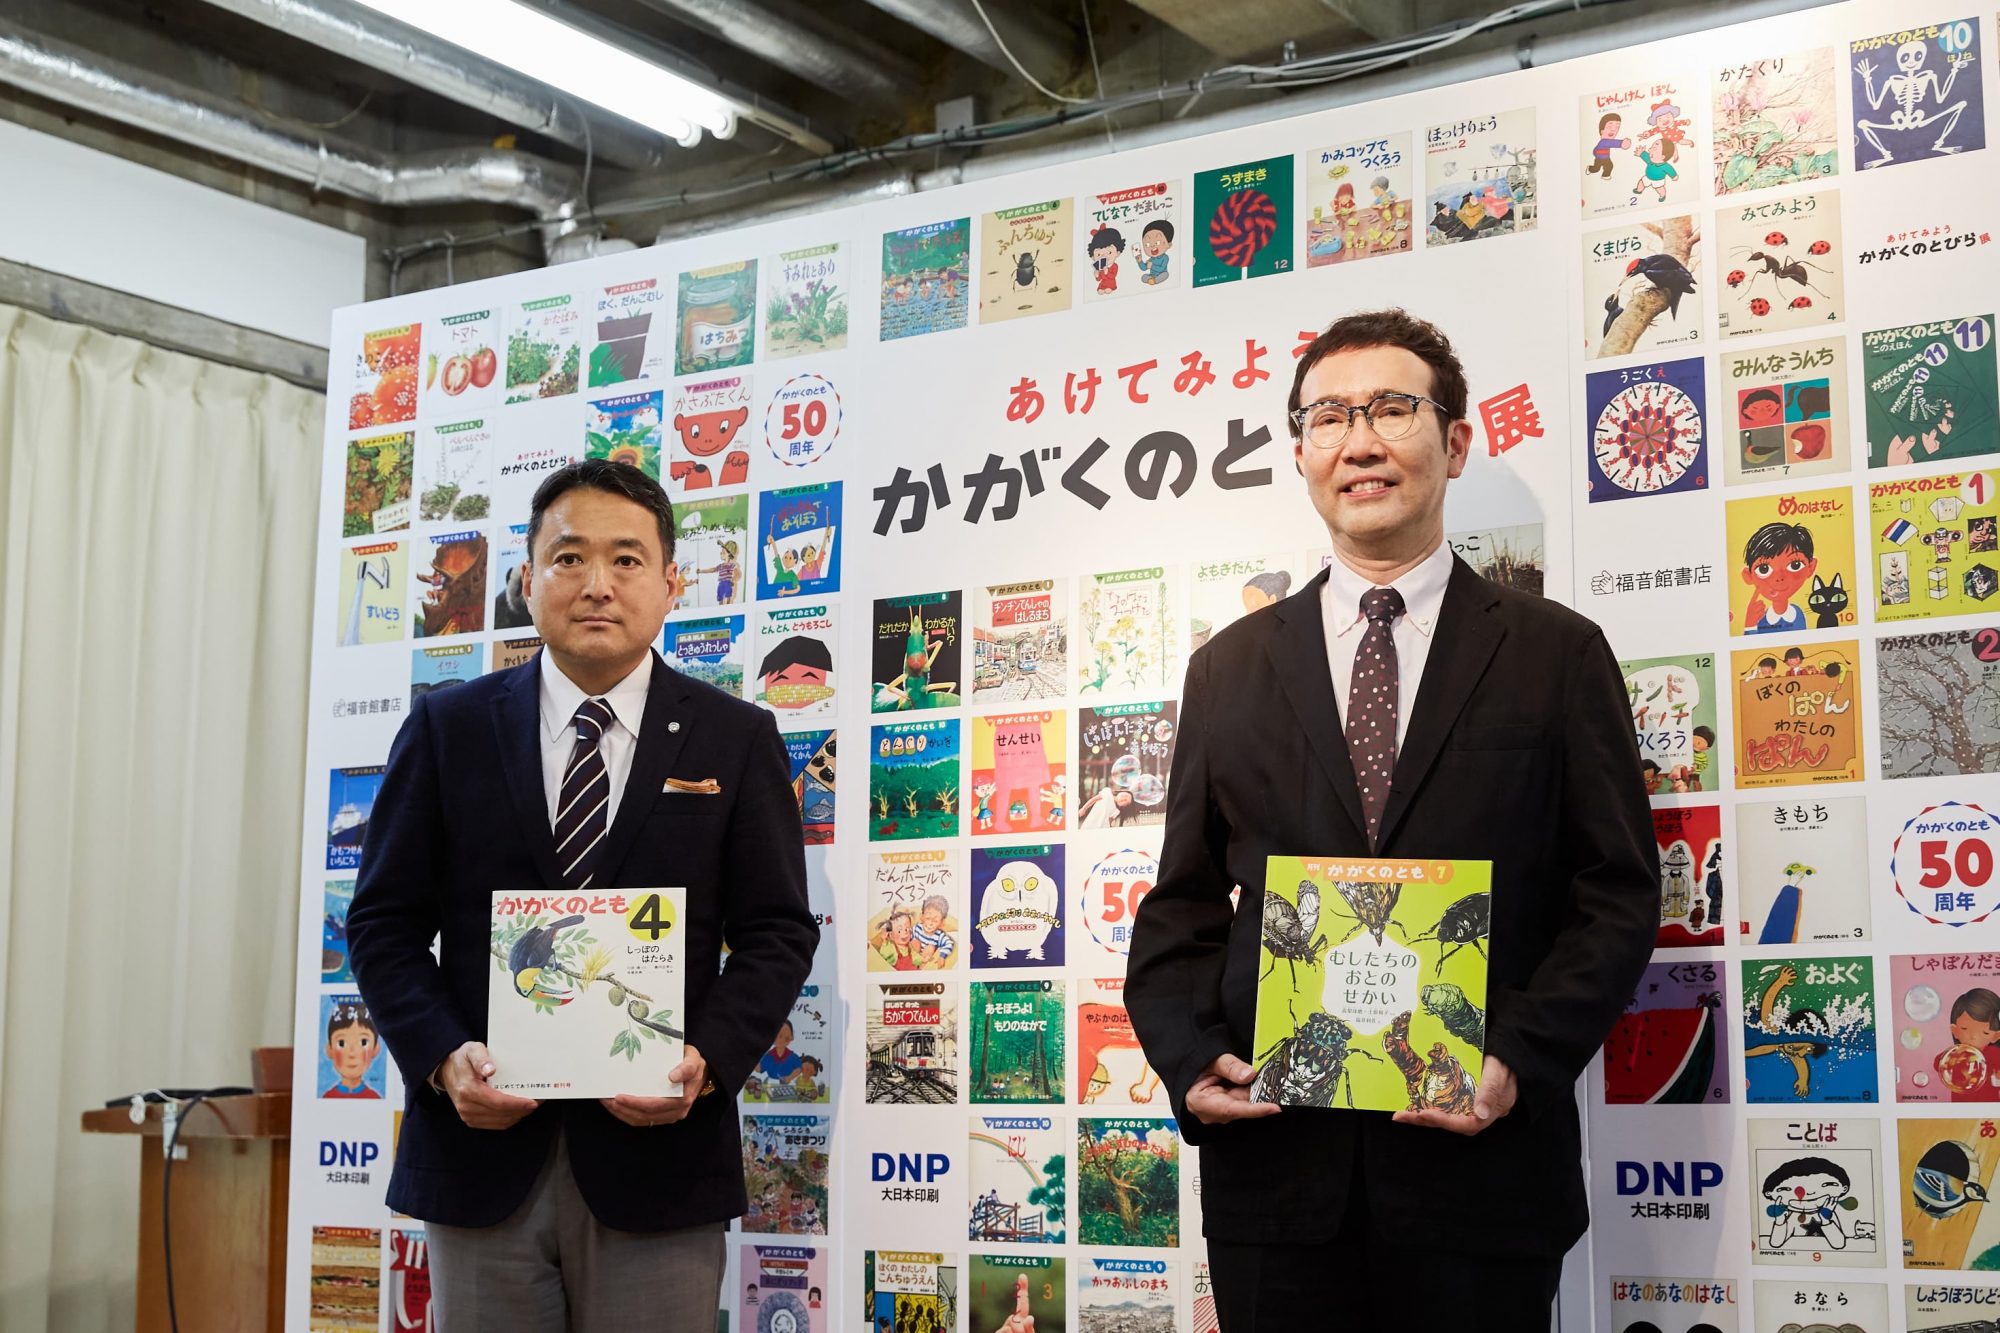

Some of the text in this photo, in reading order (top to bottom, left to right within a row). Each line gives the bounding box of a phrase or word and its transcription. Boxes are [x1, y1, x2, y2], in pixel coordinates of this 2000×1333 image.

[1851, 22, 1972, 53] かがくのとも 10
[1720, 58, 1784, 82] かたくり
[1596, 83, 1676, 108] じゃんけん ぽん
[1428, 116, 1497, 143] ほっけりょう
[1321, 140, 1387, 163] かみコップで
[1458, 140, 1466, 148] 2
[1361, 151, 1401, 168] つくろう
[1822, 164, 1831, 174] 3
[1220, 168, 1267, 188] うずまき
[1110, 188, 1153, 202] かがくのとも
[1630, 196, 1638, 206] 2
[1006, 203, 1047, 218] かがくのとも
[1093, 198, 1173, 222] てじなで だましっこ
[1741, 196, 1816, 221] みてみよう
[906, 224, 945, 236] かがくのとも
[1887, 224, 1951, 243] あけてみよう
[1400, 240, 1407, 248] 8
[1593, 236, 1641, 258] くまげら
[783, 259, 836, 281] すみれとあり
[1274, 260, 1288, 269] 12
[1827, 312, 1836, 320] 4
[452, 327, 479, 341] トマト
[700, 329, 749, 345] はちみつ
[1690, 330, 1698, 340] 3
[1865, 319, 1984, 349] かがくのとも 11
[1871, 341, 1912, 353] このえほん
[1871, 343, 1946, 392] かがくのとも 11
[675, 387, 750, 411] かさぶたくん
[782, 385, 827, 399] かがくのとも
[607, 395, 642, 406] かがくのとも
[781, 400, 827, 439] 50
[518, 449, 554, 461] あけてみよう
[789, 441, 814, 457] 周年
[1782, 466, 1790, 475] 7
[1696, 475, 1704, 485] 6
[1871, 473, 1984, 505] かがくのとも 1
[1778, 496, 1843, 516] めのはなし
[1198, 558, 1266, 579] よもぎだんご
[1106, 571, 1150, 583] かがくのとも
[1615, 565, 1712, 593] 福音館書店
[998, 581, 1041, 594] かがくのとも
[366, 605, 399, 620] すいどう
[778, 608, 815, 618] かがくのとも
[994, 600, 1050, 612] チンチンでんしゃの
[1015, 610, 1048, 622] はしるまち
[1839, 612, 1853, 623] 10
[761, 619, 832, 634] とん とん とうもろこし
[879, 621, 909, 634] だれだか
[678, 641, 728, 656] とっきゅうれっしゃ
[1881, 630, 2000, 660] かがくのとも 2
[1695, 658, 1710, 668] 12
[1755, 681, 1801, 701] ぼくの
[347, 698, 401, 715] 福音館書店
[1105, 703, 1150, 714] かがくのとも
[1789, 693, 1850, 716] ぱん
[996, 714, 1039, 725] かがくのとも
[894, 724, 935, 733] かがくのとも
[1774, 720, 1835, 738] わたしの
[996, 733, 1041, 747] せんせい
[1130, 741, 1169, 758] あそぼう
[1746, 734, 1828, 771] ぱん
[1850, 769, 1856, 779] 1
[1773, 804, 1829, 825] きもち
[1916, 820, 1990, 834] かがくのとも
[1101, 864, 1154, 876] かがくのとも
[1919, 838, 1993, 888] 50
[876, 864, 952, 885] だんボールで
[1307, 863, 1445, 879] 月刊 かがくのとも 7
[882, 884, 926, 903] つくろう
[1935, 892, 1976, 912] 周年
[497, 893, 671, 940] かがくのとも 4
[1854, 928, 1863, 937] 3
[627, 945, 659, 954] しっぽの
[642, 954, 674, 963] はたらき
[1330, 951, 1416, 968] むしたちの
[1345, 970, 1396, 986] おとの
[1667, 963, 1716, 984] くさる
[1805, 962, 1863, 985] およぐ
[1344, 989, 1396, 1004] せかい
[985, 1003, 1032, 1014] あそぼうよ!
[994, 1020, 1047, 1032] もりのなかで
[1713, 1088, 1723, 1098] 6
[1862, 1090, 1871, 1101] 8
[995, 1120, 1038, 1129] かがくのとも
[1105, 1120, 1150, 1128] かがくのとも
[1786, 1123, 1837, 1142] ことば
[785, 1135, 826, 1146] あきまつり
[1008, 1136, 1026, 1157] にじ
[320, 1141, 379, 1167] DNP
[872, 1153, 950, 1182] DNP
[326, 1172, 370, 1184] 大日本印刷
[1615, 1160, 1723, 1196] DNP
[882, 1188, 939, 1202] 大日本印刷
[1631, 1202, 1710, 1220] 大日本印刷
[995, 1257, 1038, 1266] かがくのとも
[1813, 1252, 1821, 1262] 9
[879, 1264, 927, 1273] ぼくの わたしの
[1106, 1262, 1151, 1271] かがくのとも
[879, 1273, 935, 1285] こんちゅうえん
[1091, 1277, 1168, 1291] かつおぶしのまち
[1614, 1281, 1735, 1305] はなのあなのはなし
[1794, 1290, 1849, 1305] おなら
[1916, 1287, 2000, 1306] しょうぼうじど
